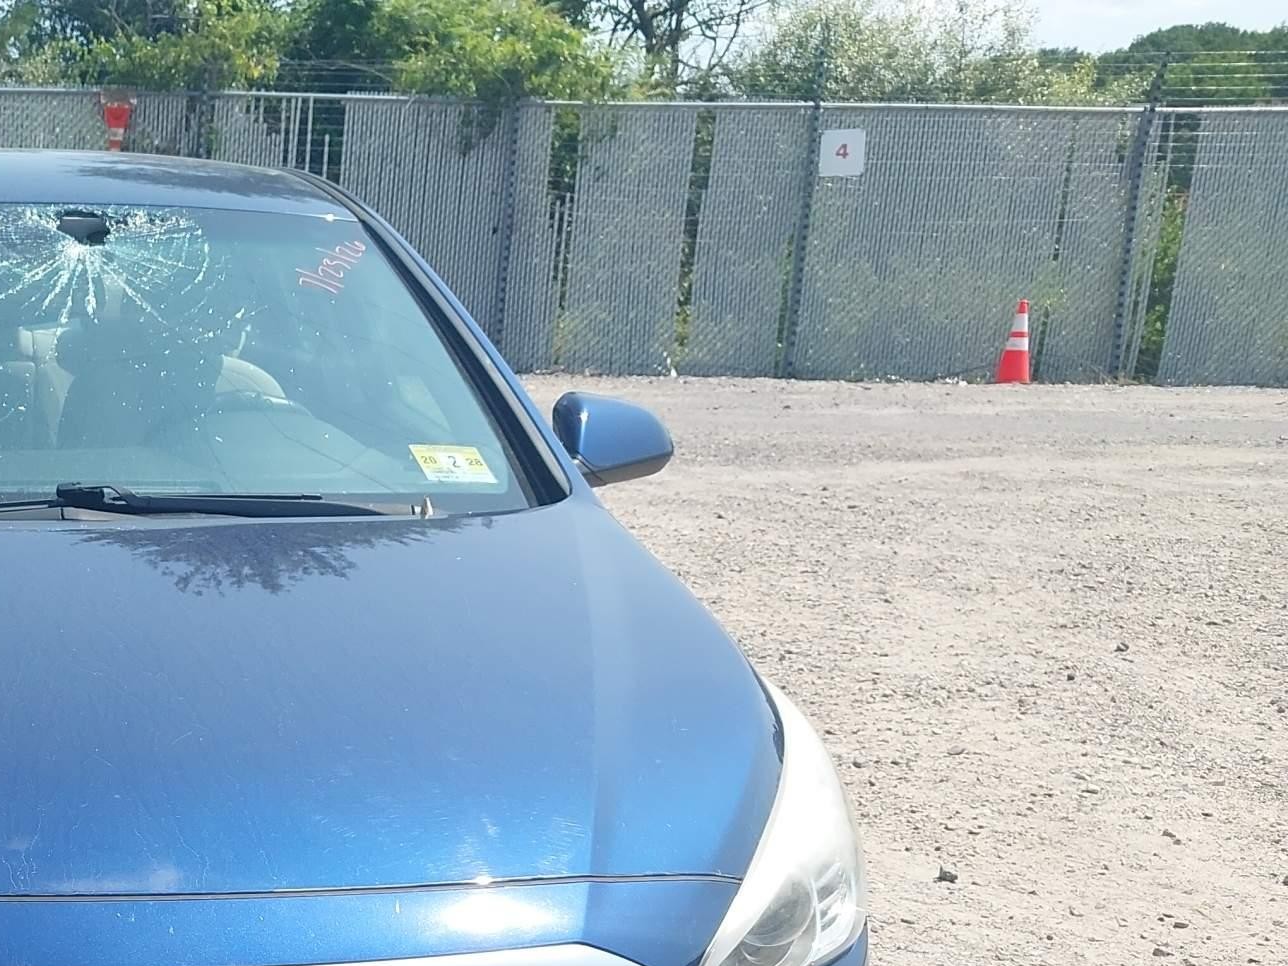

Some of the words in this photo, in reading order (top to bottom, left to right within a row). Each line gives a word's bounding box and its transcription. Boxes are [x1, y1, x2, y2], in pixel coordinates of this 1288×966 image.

[835, 143, 849, 159] 4
[295, 240, 366, 294] 7/23/26
[420, 455, 438, 465] 20
[447, 455, 461, 469] 2
